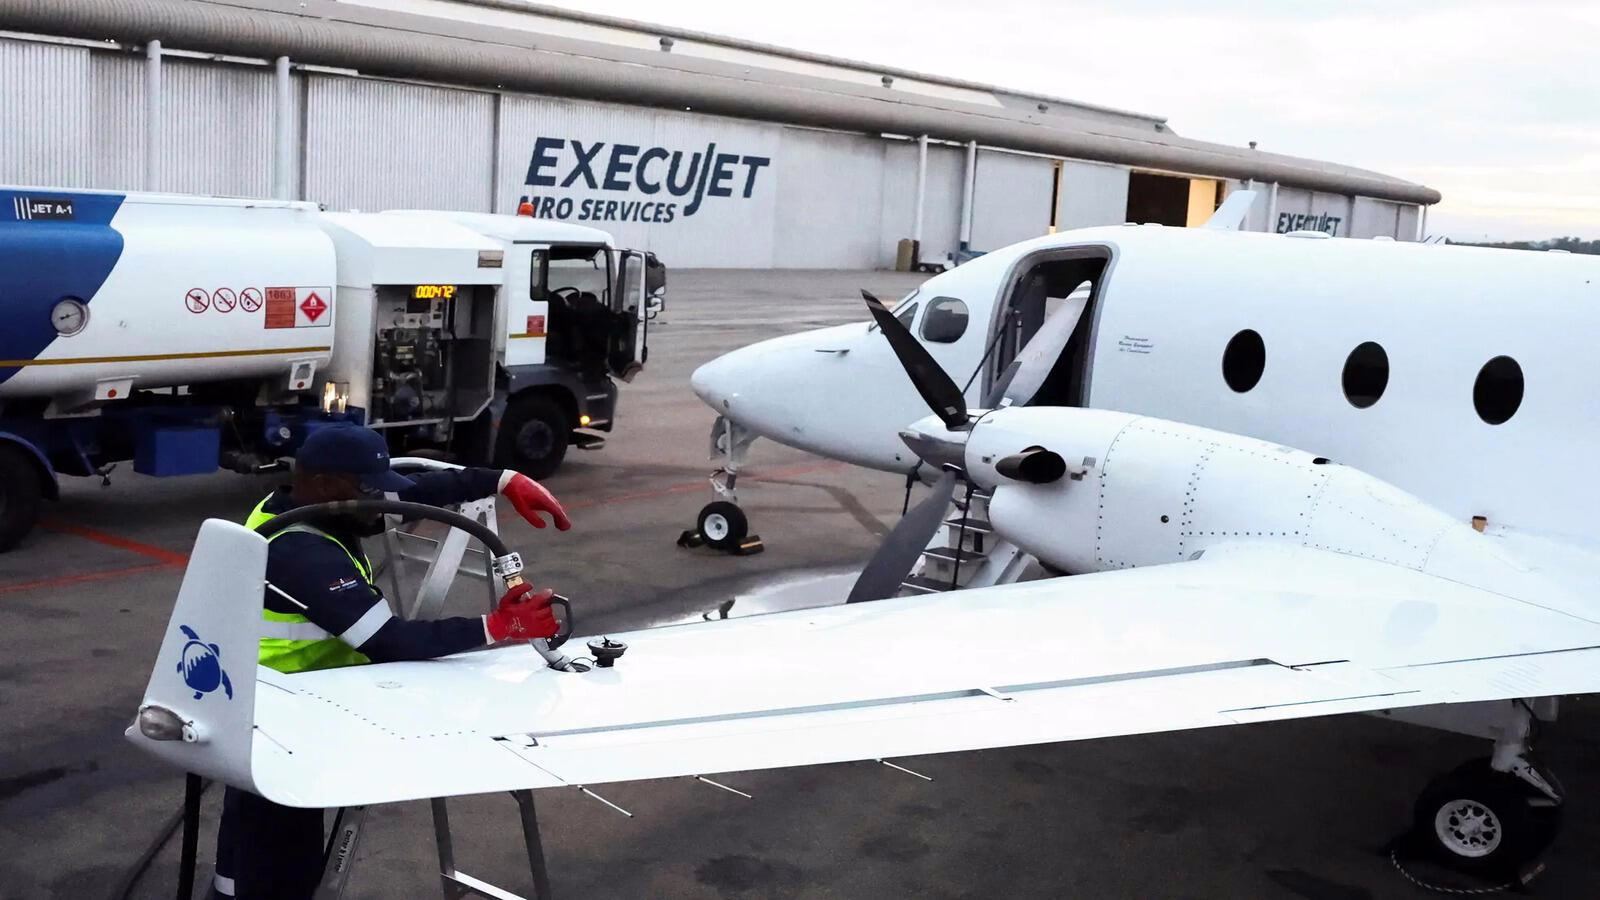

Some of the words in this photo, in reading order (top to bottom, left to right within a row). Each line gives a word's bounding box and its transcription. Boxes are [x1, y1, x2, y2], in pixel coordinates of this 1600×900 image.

[524, 136, 771, 217] EXECUJET
[32, 204, 52, 214] JET
[56, 204, 73, 214] A-1
[578, 198, 677, 223] SERVICES
[1276, 211, 1342, 238] EXECUJET
[269, 289, 292, 300] 1863
[415, 285, 454, 299] 000472
